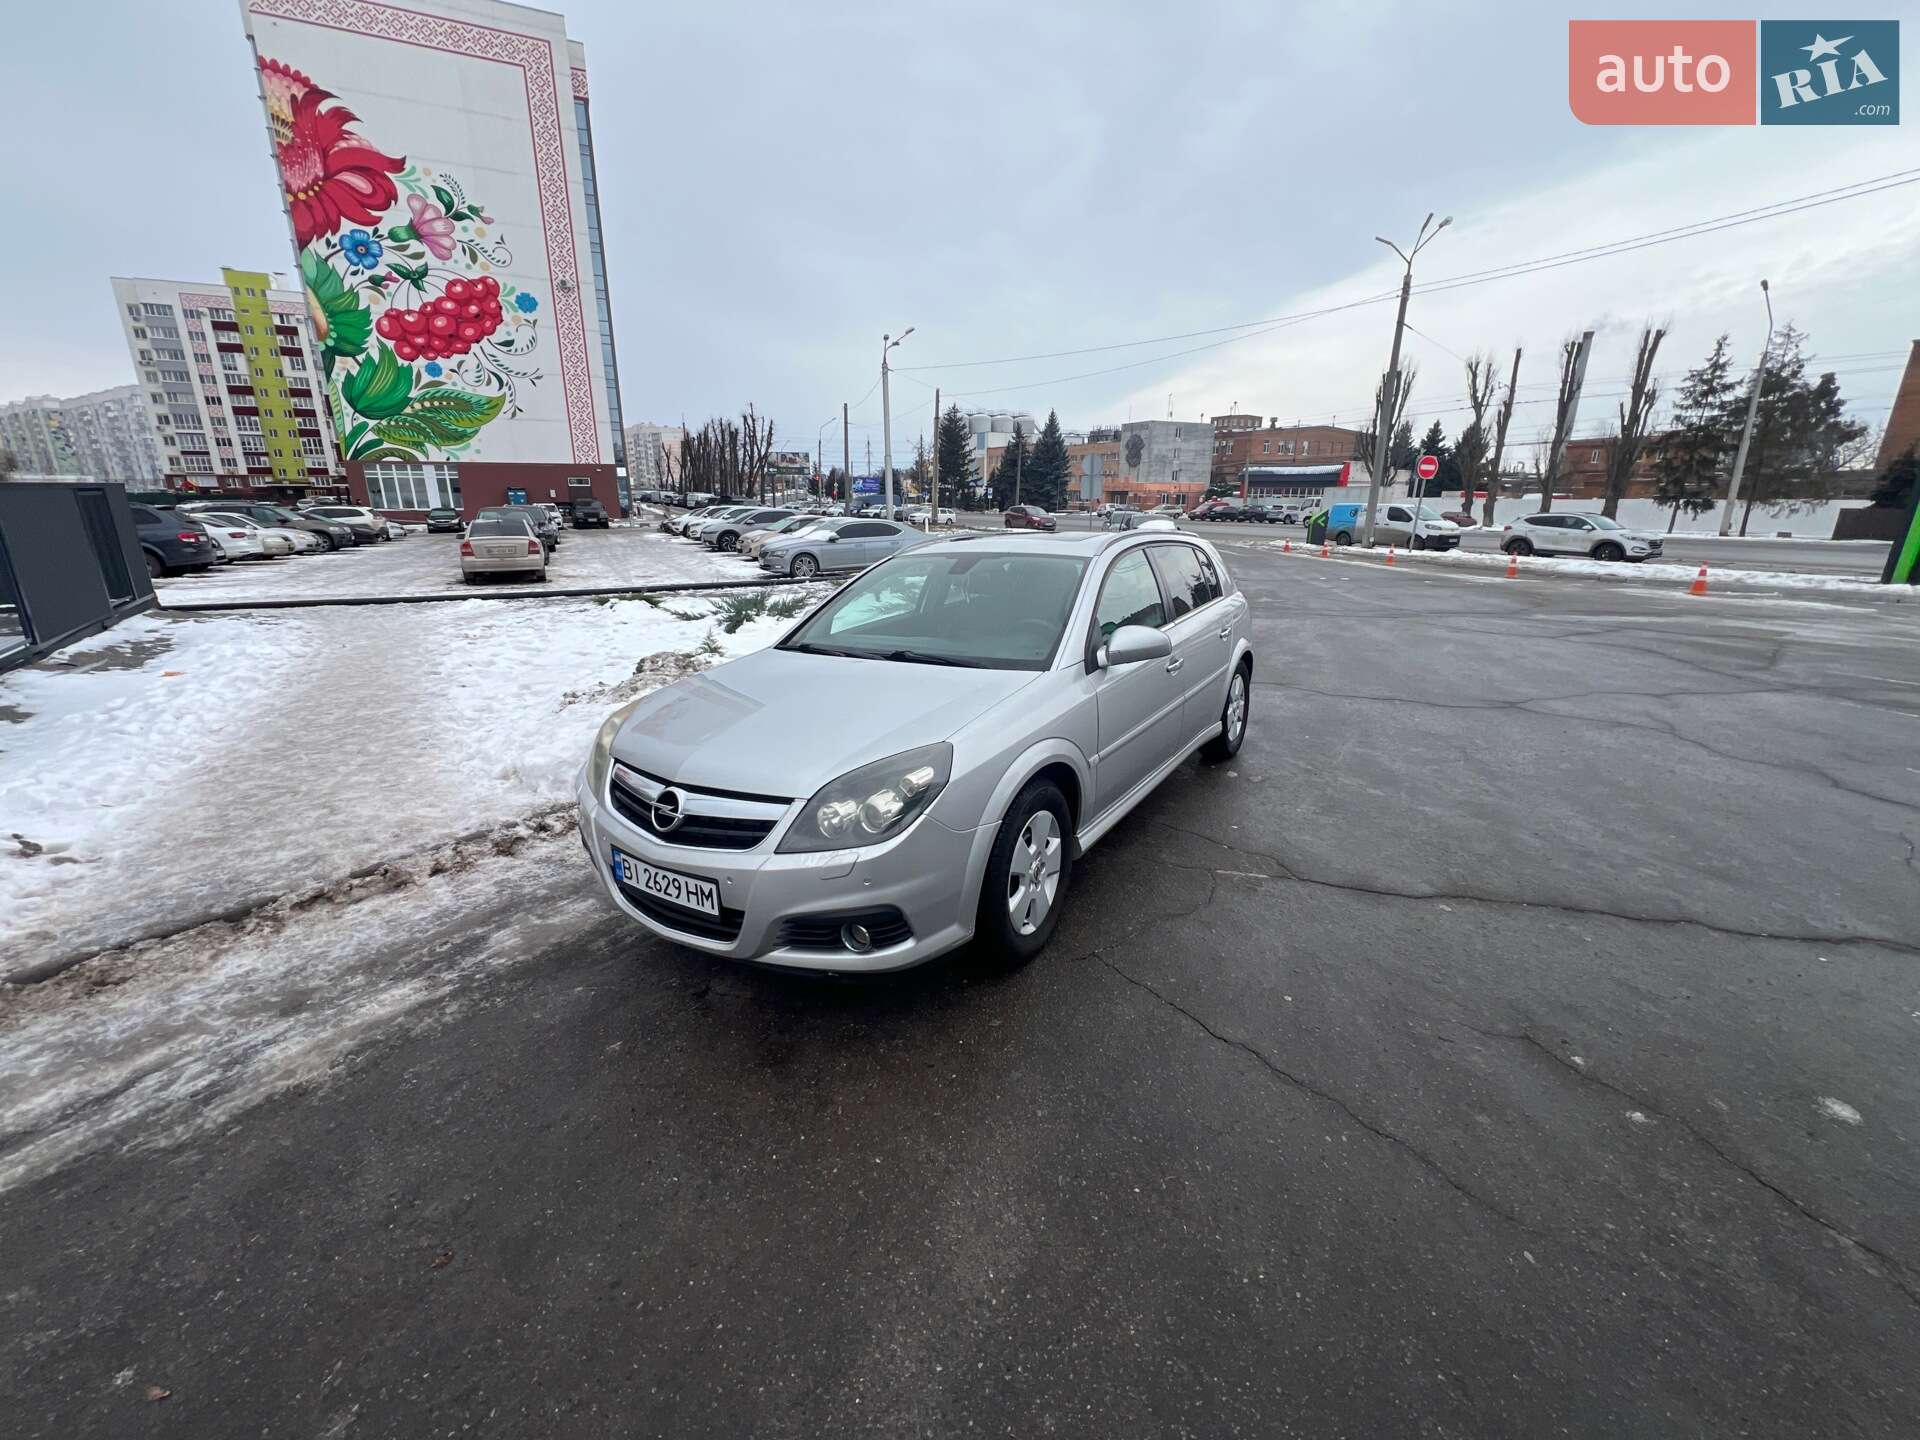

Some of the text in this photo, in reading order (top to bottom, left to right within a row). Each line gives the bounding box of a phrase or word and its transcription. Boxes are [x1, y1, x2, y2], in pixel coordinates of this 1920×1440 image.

[622, 858, 715, 910] BI 2629 HM
